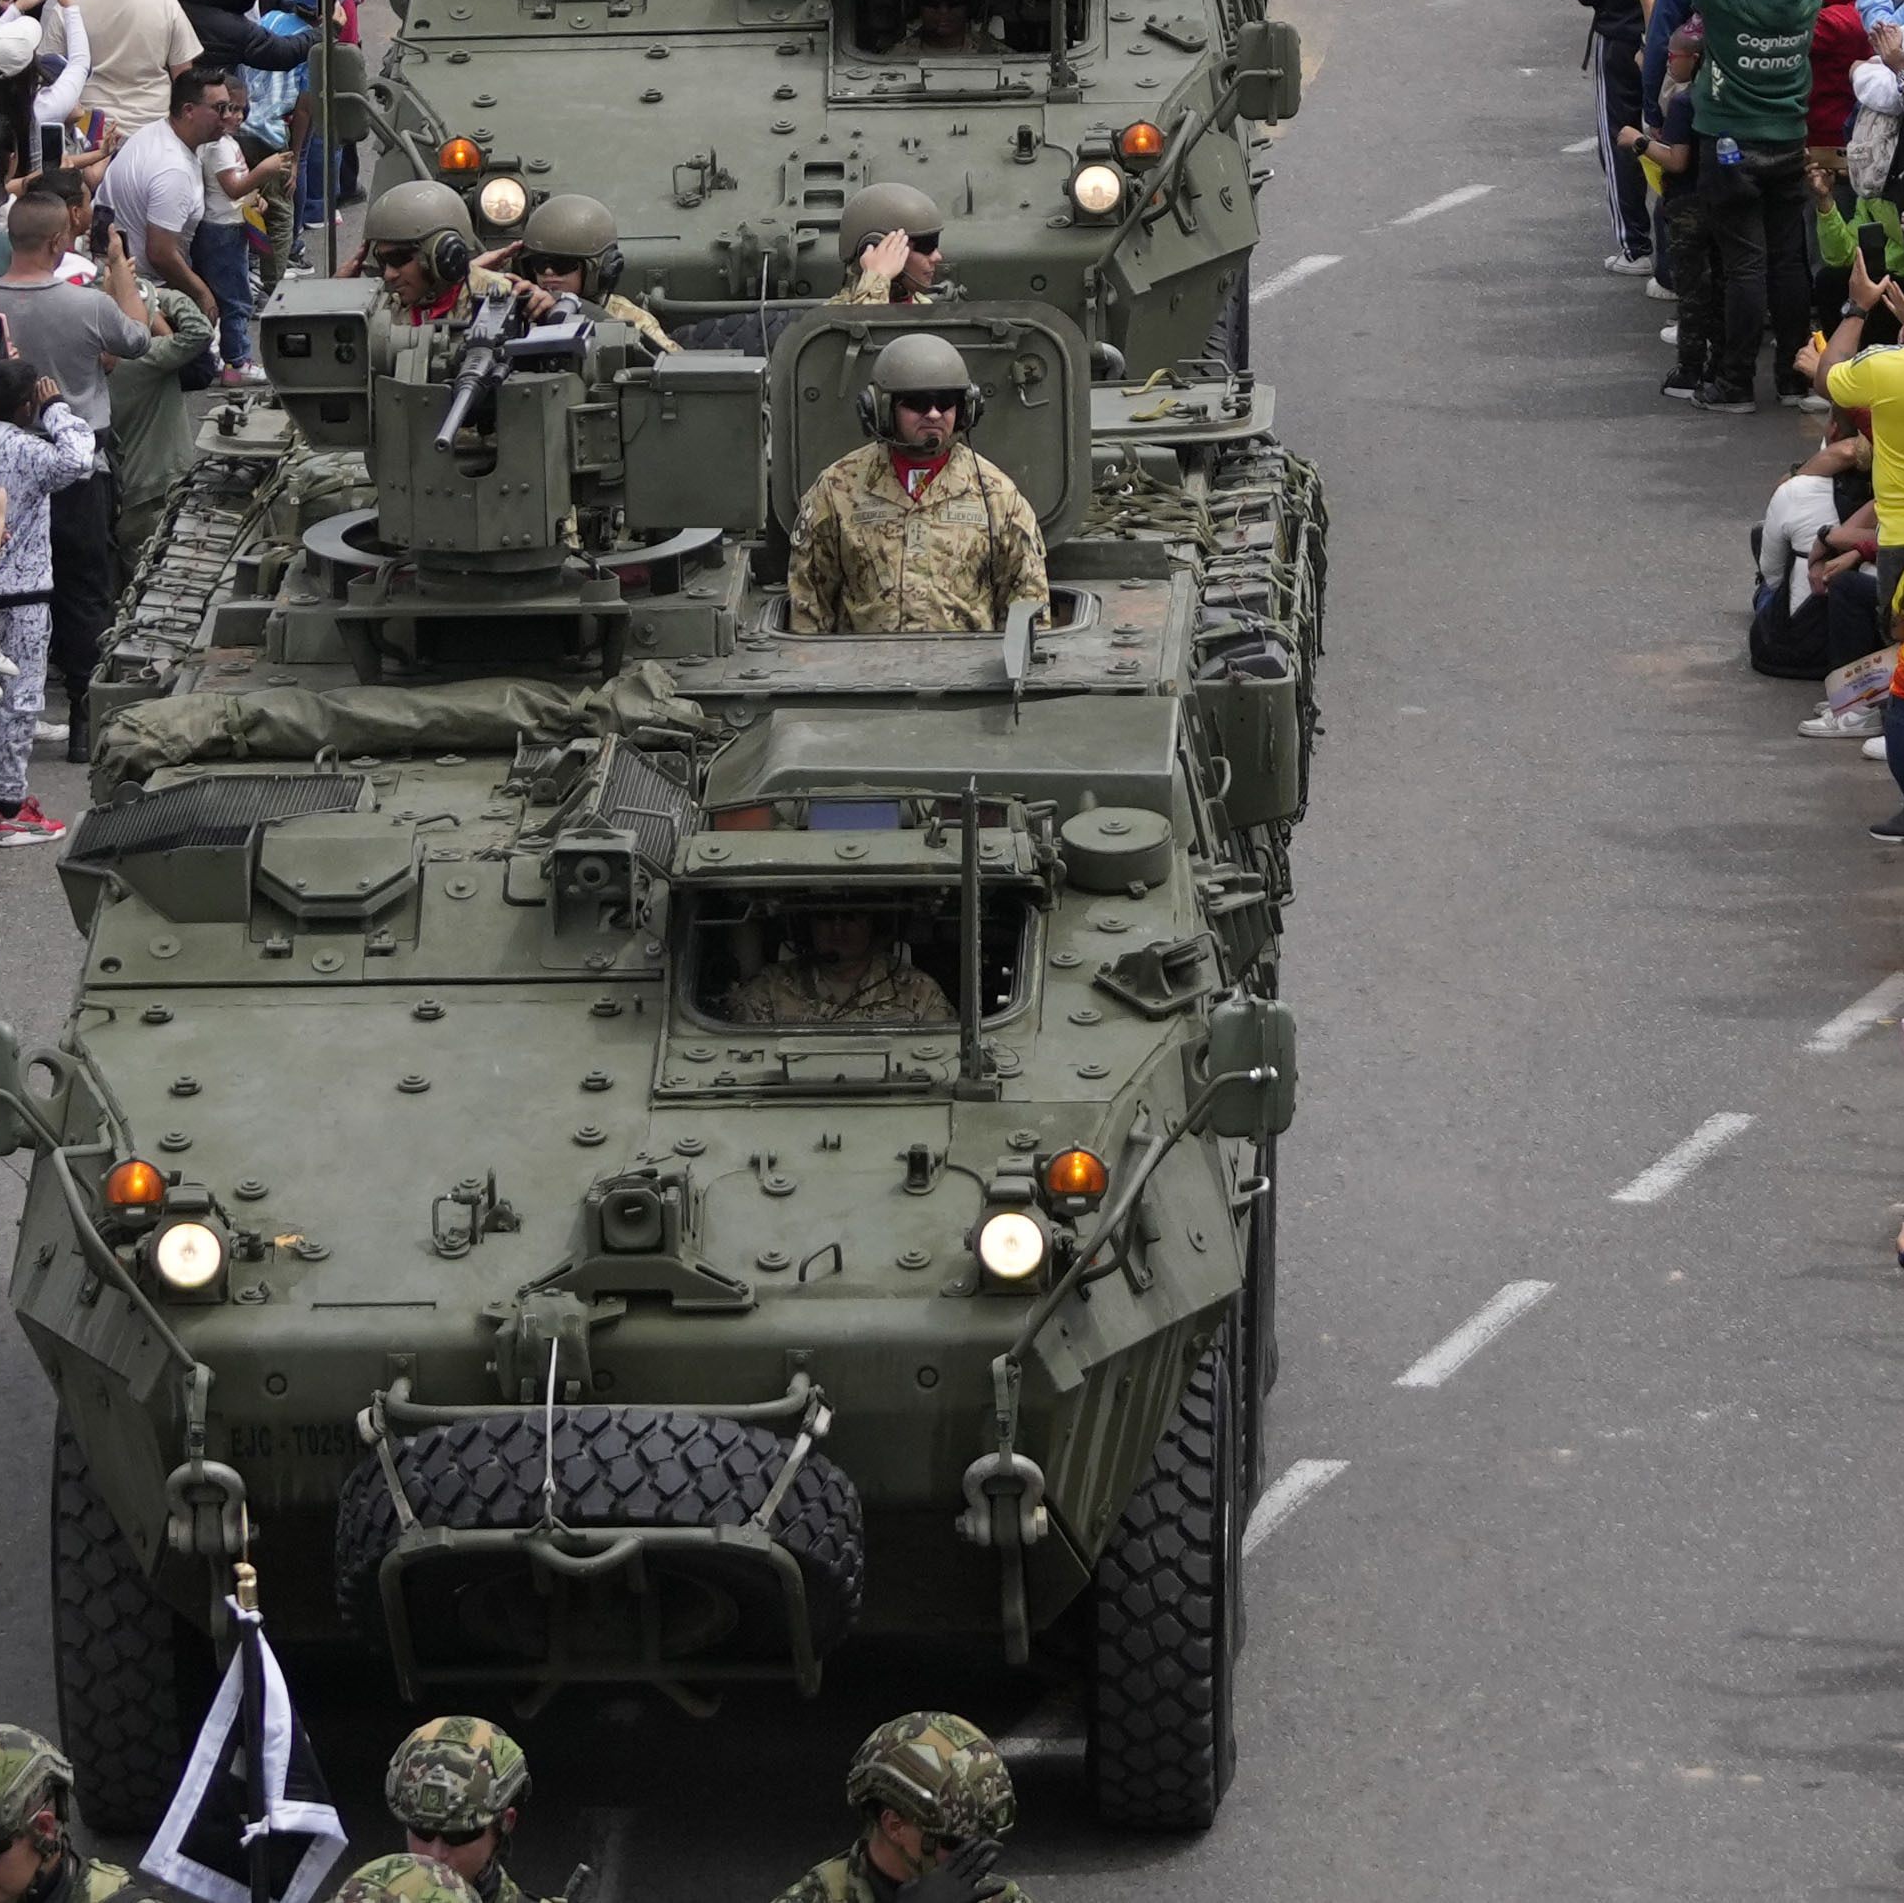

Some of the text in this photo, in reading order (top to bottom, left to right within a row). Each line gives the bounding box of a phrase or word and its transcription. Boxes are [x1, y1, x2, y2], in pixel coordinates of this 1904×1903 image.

[1736, 29, 1808, 53] Cognizant
[1738, 53, 1803, 70] aramco
[231, 1426, 272, 1457] EJC
